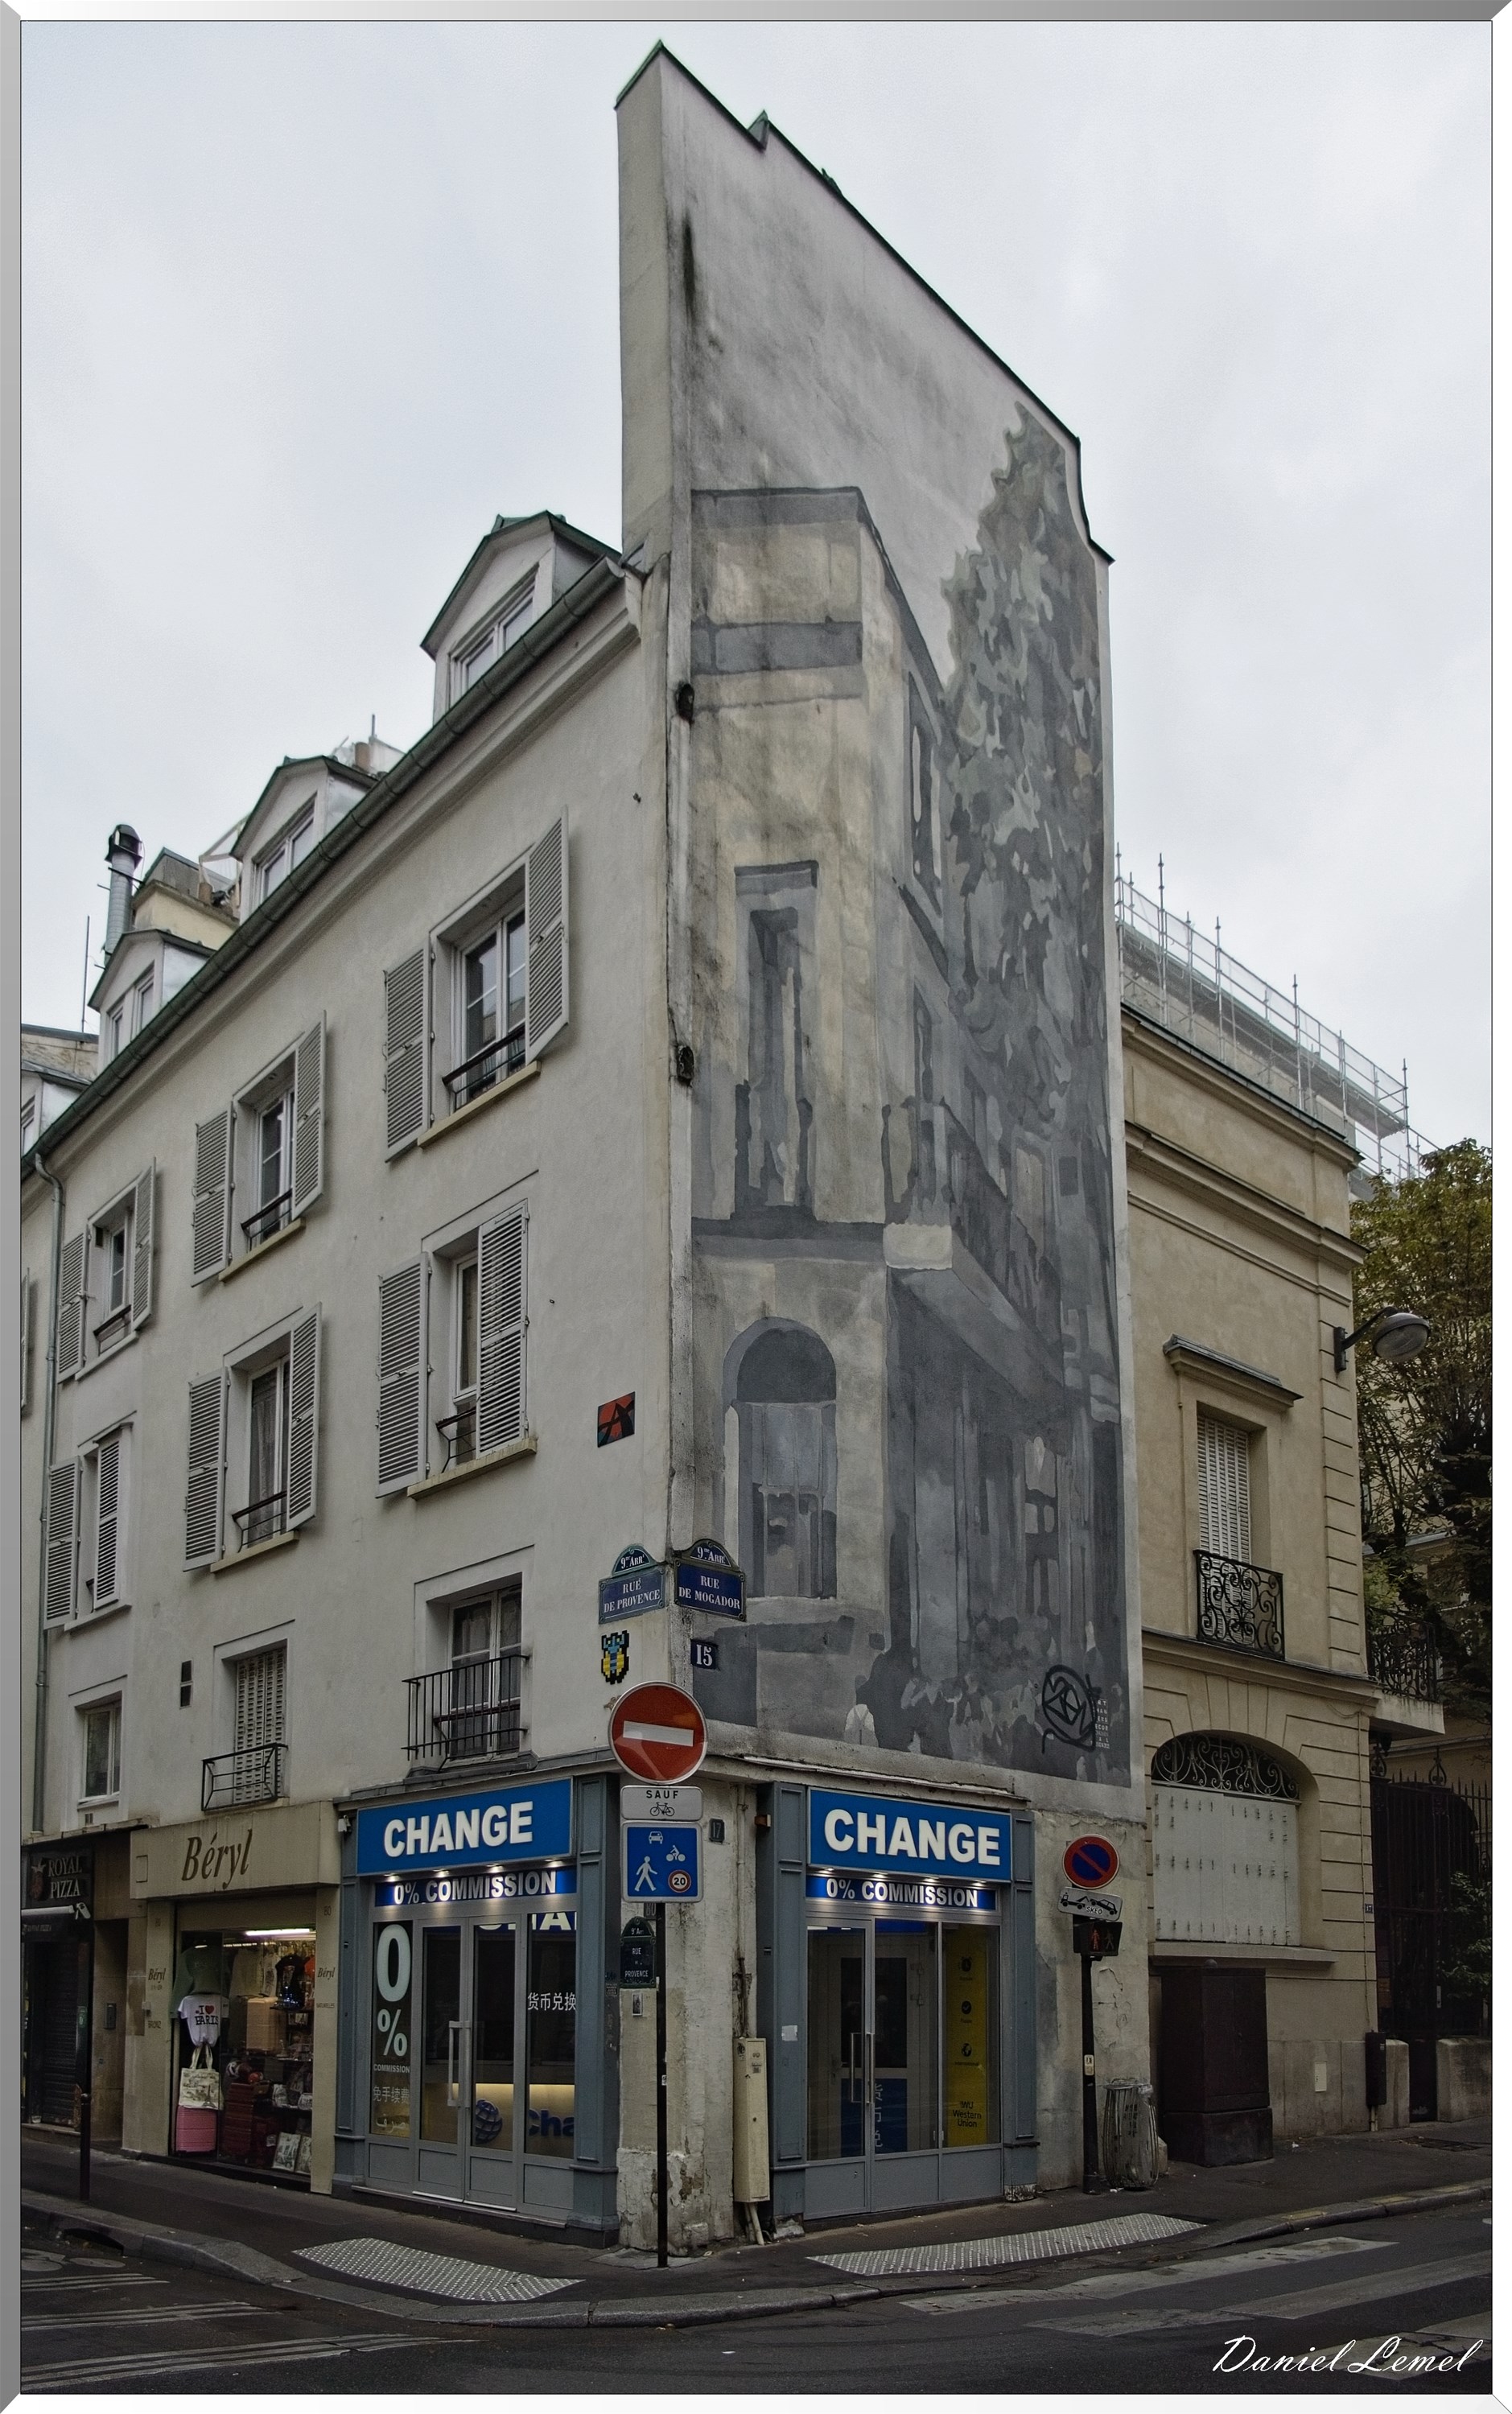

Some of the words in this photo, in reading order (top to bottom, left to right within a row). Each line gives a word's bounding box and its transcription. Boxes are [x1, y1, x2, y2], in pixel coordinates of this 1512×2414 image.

[623, 1580, 641, 1594] RUE
[700, 1576, 719, 1589] RUE
[604, 1601, 615, 1613] DE
[617, 1589, 660, 1609] PROVENCE
[678, 1586, 691, 1599] DE
[694, 1589, 741, 1609] MOGADOR
[696, 1644, 713, 1666] 15
[646, 1790, 679, 1798] SAUF
[384, 1800, 534, 1858] CHANGE
[713, 1822, 722, 1839] 17
[824, 1809, 1000, 1866] CHANGE
[47, 1856, 82, 1877] ROYAL
[181, 1828, 253, 1890] Béryl
[50, 1879, 80, 1899] PIZZA
[393, 1882, 420, 1905] 0%
[426, 1870, 556, 1902] COMMISSION
[674, 1877, 686, 1885] 20
[826, 1878, 855, 1899] 0%
[862, 1881, 978, 1908] COMMISSION
[377, 1923, 411, 2002] 0
[148, 1968, 166, 1983] Béryl
[317, 1967, 336, 1980] Béryl
[624, 1970, 649, 1978] PROVENCE
[527, 1992, 576, 2012] 货币兑换
[195, 2015, 219, 2025] PARIS
[373, 2064, 410, 2073] COMMISSION
[373, 2086, 410, 2104] 免手续费
[952, 2109, 982, 2119] Western
[958, 2119, 978, 2128] Union
